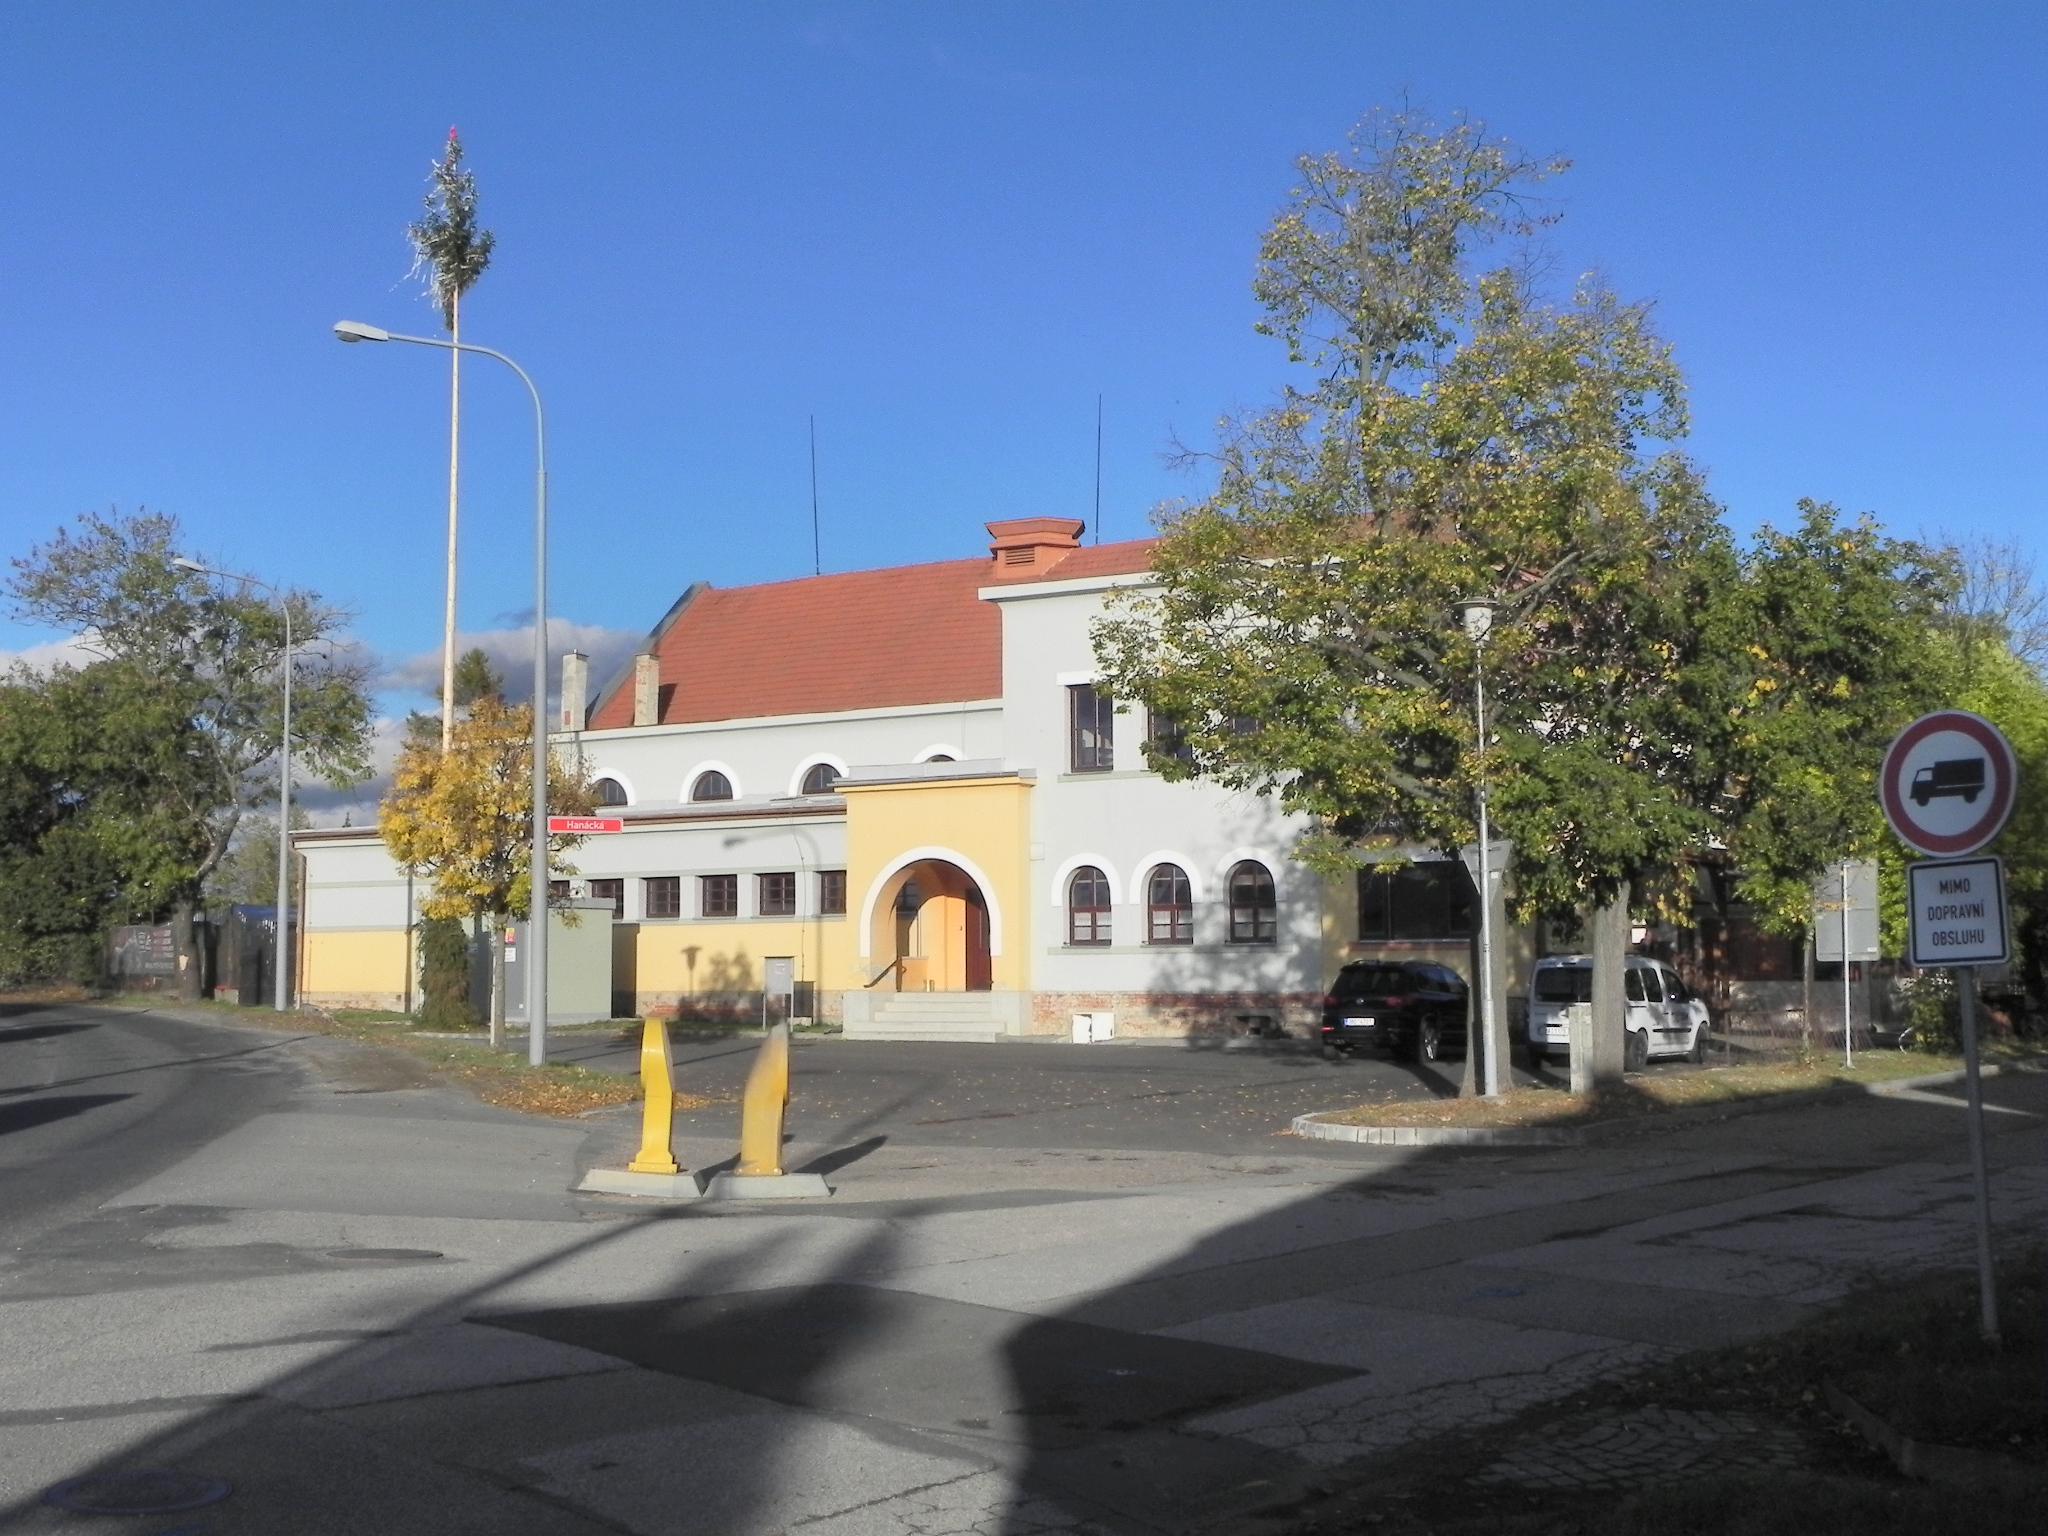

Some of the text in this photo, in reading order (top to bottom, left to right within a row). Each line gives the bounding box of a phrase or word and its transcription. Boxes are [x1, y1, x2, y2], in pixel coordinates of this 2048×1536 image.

[567, 820, 604, 829] Hanácká
[1939, 878, 1970, 895] MIMO
[1928, 900, 1984, 921] DOPRAVNÍ
[1932, 929, 1984, 946] OBSLUHU
